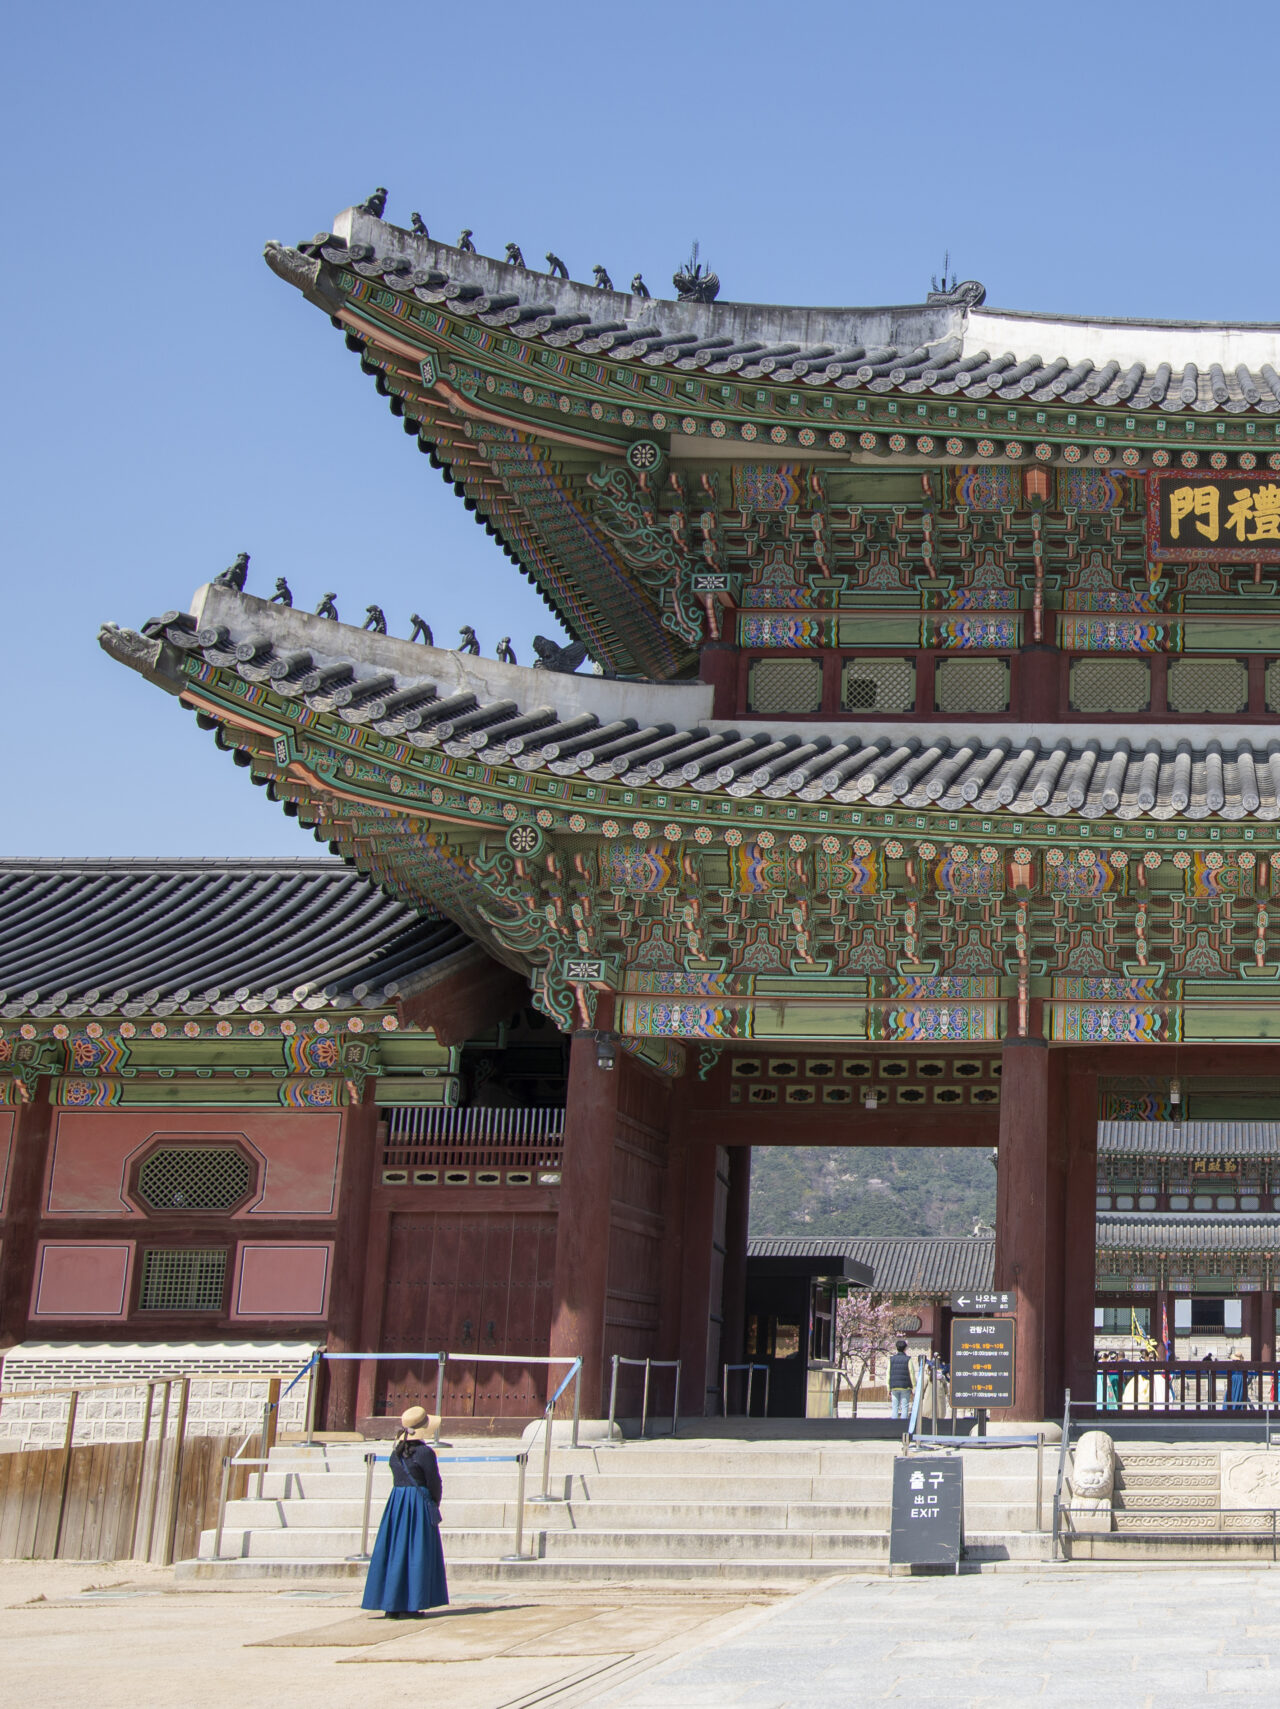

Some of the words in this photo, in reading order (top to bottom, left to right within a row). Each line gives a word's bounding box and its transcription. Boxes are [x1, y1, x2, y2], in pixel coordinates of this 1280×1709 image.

[975, 1294, 998, 1303] 나오는
[909, 1470, 945, 1490] 출구
[914, 1494, 938, 1505] 出口
[911, 1508, 940, 1518] EXIT
